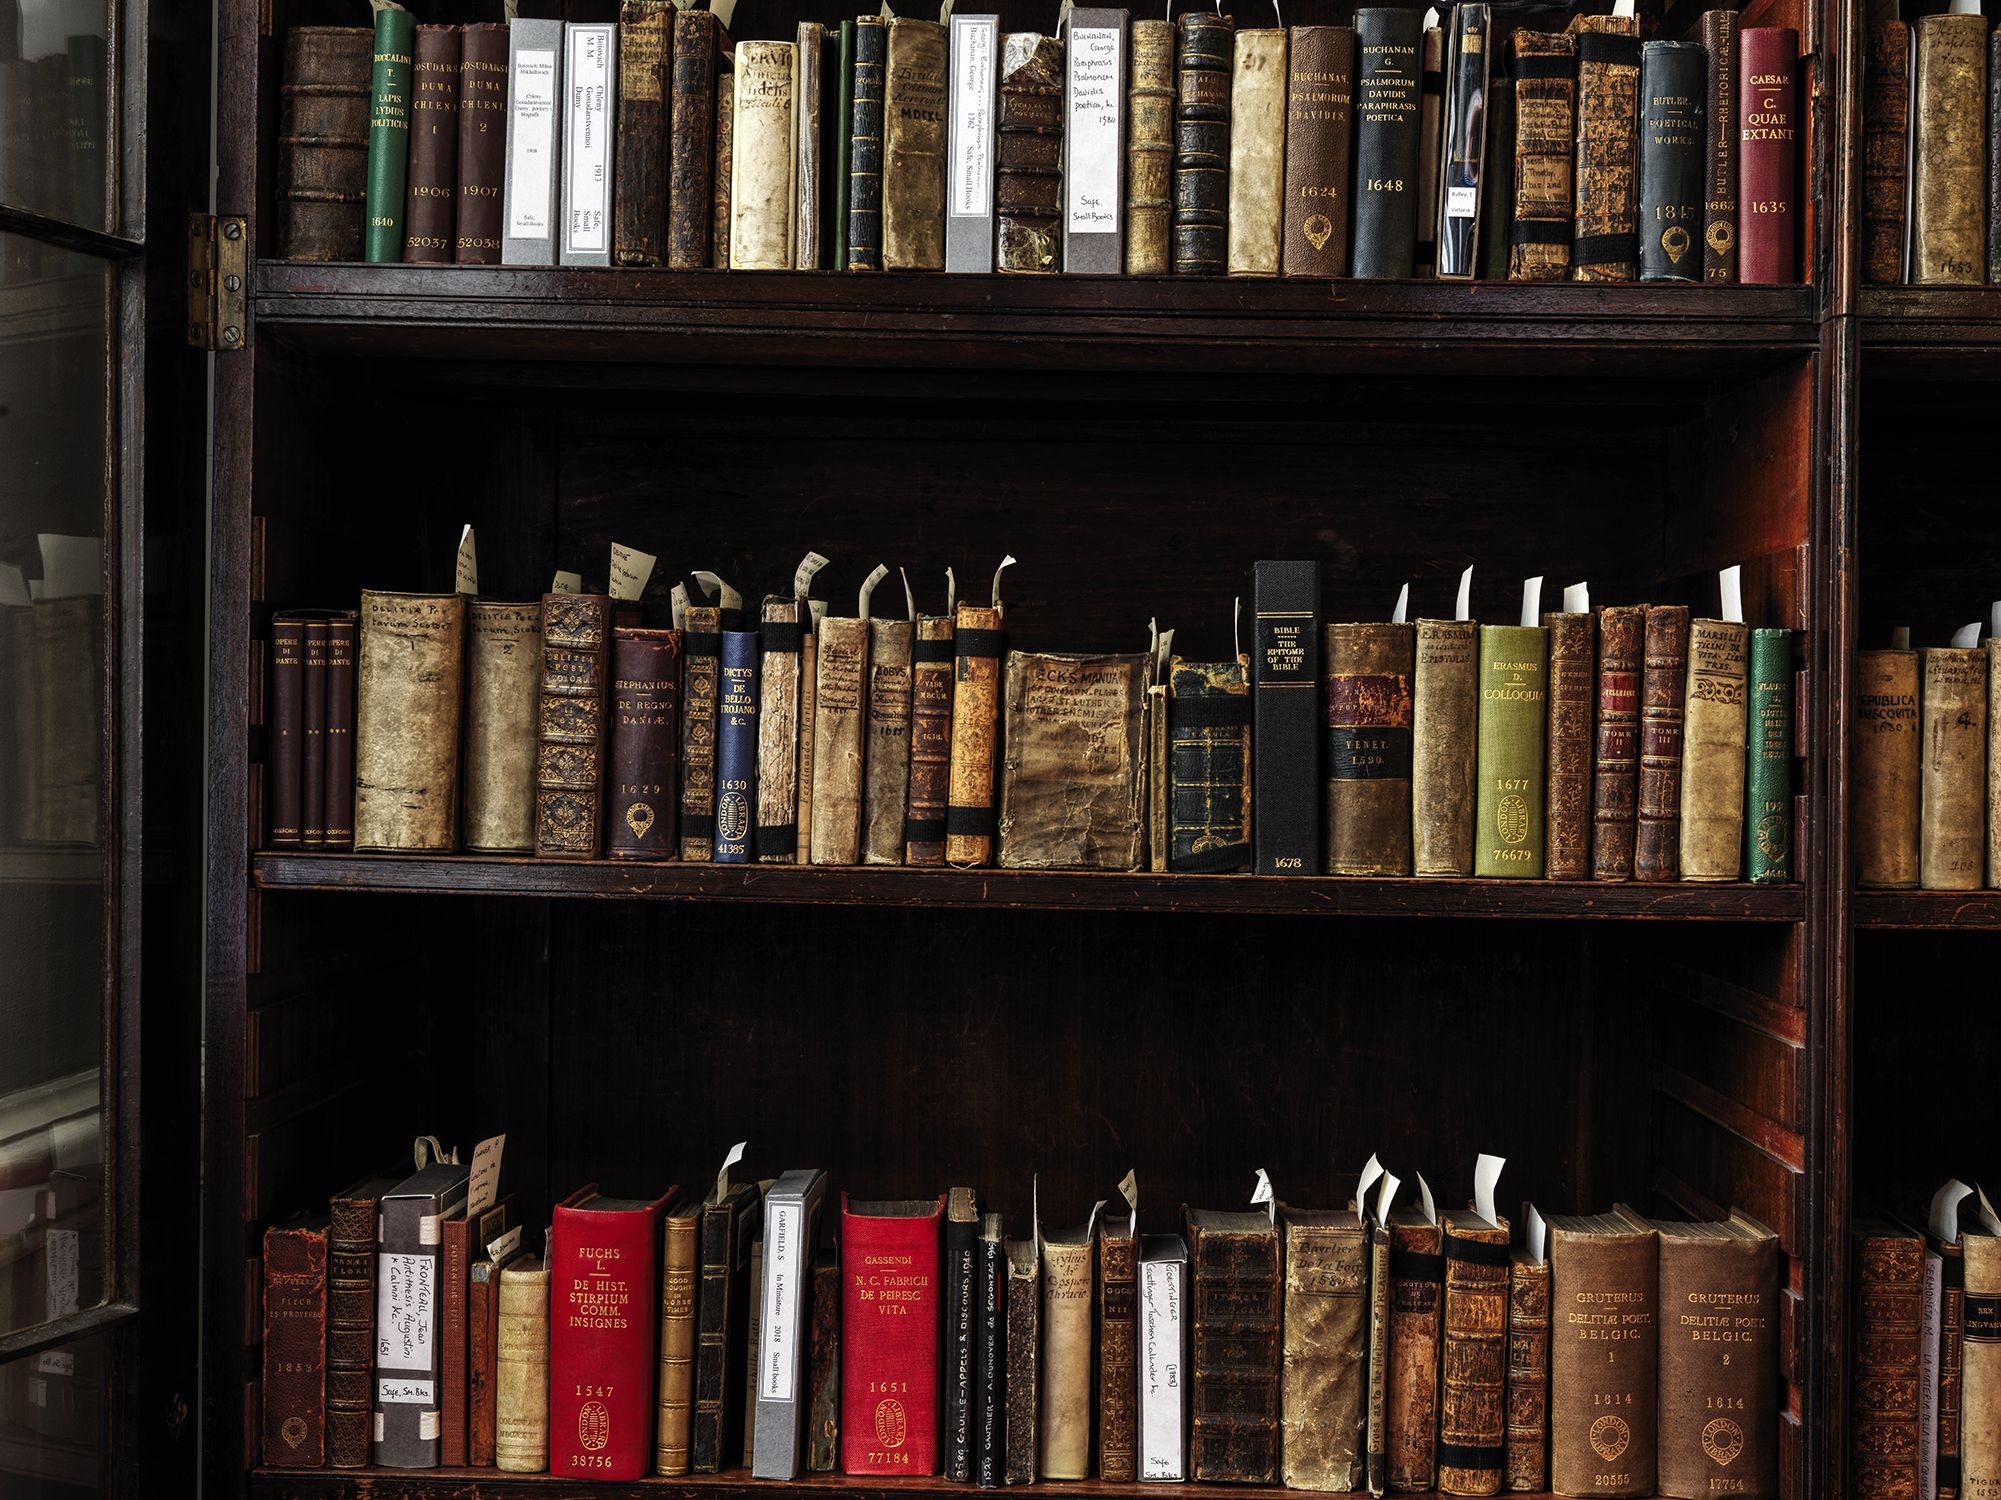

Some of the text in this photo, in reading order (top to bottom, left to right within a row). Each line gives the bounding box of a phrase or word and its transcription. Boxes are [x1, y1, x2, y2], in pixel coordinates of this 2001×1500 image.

[597, 35, 605, 69] Boiovich
[1363, 46, 1415, 55] BUCHANAN
[1384, 58, 1394, 66] G.
[967, 66, 976, 91] George
[1360, 79, 1415, 87] PSALMORUM
[1750, 75, 1789, 85] CAESAR
[421, 82, 452, 93] DUMA
[469, 81, 500, 91] DUMA
[379, 94, 401, 103] LAPIS
[574, 86, 584, 109] Dumy
[595, 85, 604, 113] Chleny
[1292, 93, 1350, 104] PSALMORUM
[1763, 98, 1777, 109] C.
[376, 106, 404, 116] LYDIUS
[1366, 114, 1404, 122] POETICA
[1748, 113, 1787, 126] QUAE
[480, 123, 487, 132] 2
[1742, 129, 1794, 141] EXTANT
[594, 164, 602, 182] 1913
[463, 185, 498, 197] 1907
[1367, 179, 1403, 191] 1648
[414, 186, 450, 198] 1906
[1300, 186, 1337, 198] 1624
[965, 187, 973, 210] Books
[1752, 201, 1786, 214] 1635
[372, 217, 393, 227] 1640
[573, 210, 581, 233] Books
[583, 210, 591, 232] Small
[593, 210, 601, 230] Safe,
[1073, 212, 1114, 222] Small Books
[407, 236, 447, 249] 52037
[457, 237, 500, 249] 52038
[1940, 257, 1973, 274] 1653
[1708, 268, 1727, 278] 75
[502, 645, 512, 655] 2
[723, 667, 752, 677] DICTYS
[1493, 662, 1538, 671] ERASMUS
[1513, 673, 1522, 681] D.
[615, 680, 676, 690] STEPHANIUS.
[733, 684, 745, 693] DE
[619, 701, 673, 709] DE REGNO
[724, 695, 751, 704] BELLO
[1073, 699, 1111, 708] LUTHER
[721, 705, 755, 714] TROJANO
[801, 689, 811, 804] Ferdinando Martini
[1346, 740, 1389, 750] VENET.
[621, 784, 660, 794] 1629
[721, 780, 747, 790] 1630
[1498, 779, 1529, 790] 1677
[720, 795, 746, 838] LONDON LIBRARY
[1500, 799, 1526, 840] LONDON LIBRARY
[717, 843, 745, 854] 41385
[1493, 849, 1531, 860] 76679
[1275, 857, 1302, 868] 1678
[776, 1210, 786, 1254] GARFIELD,
[579, 1247, 620, 1258] FUCHS
[596, 1260, 606, 1270] L.
[865, 1256, 912, 1265] GASSENDI
[775, 1273, 783, 1282] In
[855, 1276, 929, 1286] N. C. FABRICII
[574, 1279, 628, 1291] DE HIST.
[569, 1292, 628, 1304] STIRPIUM
[774, 1282, 782, 1316] Miniature
[860, 1290, 921, 1301] DE PEIRESC
[1576, 1292, 1644, 1303] GRUTERUS
[1688, 1293, 1760, 1304] GRUTERUS
[580, 1305, 621, 1315] COMM.
[878, 1305, 907, 1315] VITA
[570, 1316, 628, 1328] INSIGNES
[1568, 1312, 1651, 1325] DELITIÆ POET.
[1680, 1315, 1765, 1328] DELITIÆ POET.
[773, 1325, 781, 1344] 2018
[1579, 1329, 1641, 1340] BELGIC.
[1692, 1331, 1753, 1342] BELGIC.
[380, 1337, 391, 1356] 1651
[985, 1262, 995, 1450] GAUTHIER SEGONZAC
[1608, 1351, 1614, 1363] 1
[1722, 1353, 1731, 1365] 2
[1923, 1353, 1933, 1365] LA
[772, 1351, 781, 1375] Small
[576, 1385, 614, 1397] 1547
[770, 1376, 779, 1394] books
[870, 1382, 907, 1392] 1651
[1594, 1393, 1632, 1405] 1614
[1707, 1397, 1744, 1409] 1614
[581, 1405, 592, 1446] LONDON
[596, 1406, 607, 1447] LIBRARY
[878, 1402, 903, 1446] LONDON LIBRARY
[1369, 1388, 1382, 1453] Gross as to
[1592, 1416, 1627, 1438] LONDON
[1704, 1419, 1741, 1440] LONDON
[1592, 1438, 1628, 1456] LIBRARY
[1704, 1438, 1742, 1459] LIBRARY
[571, 1455, 612, 1467] 38756
[868, 1452, 909, 1464] 77184
[1595, 1474, 1630, 1486] 20555
[1709, 1478, 1744, 1490] 17754
